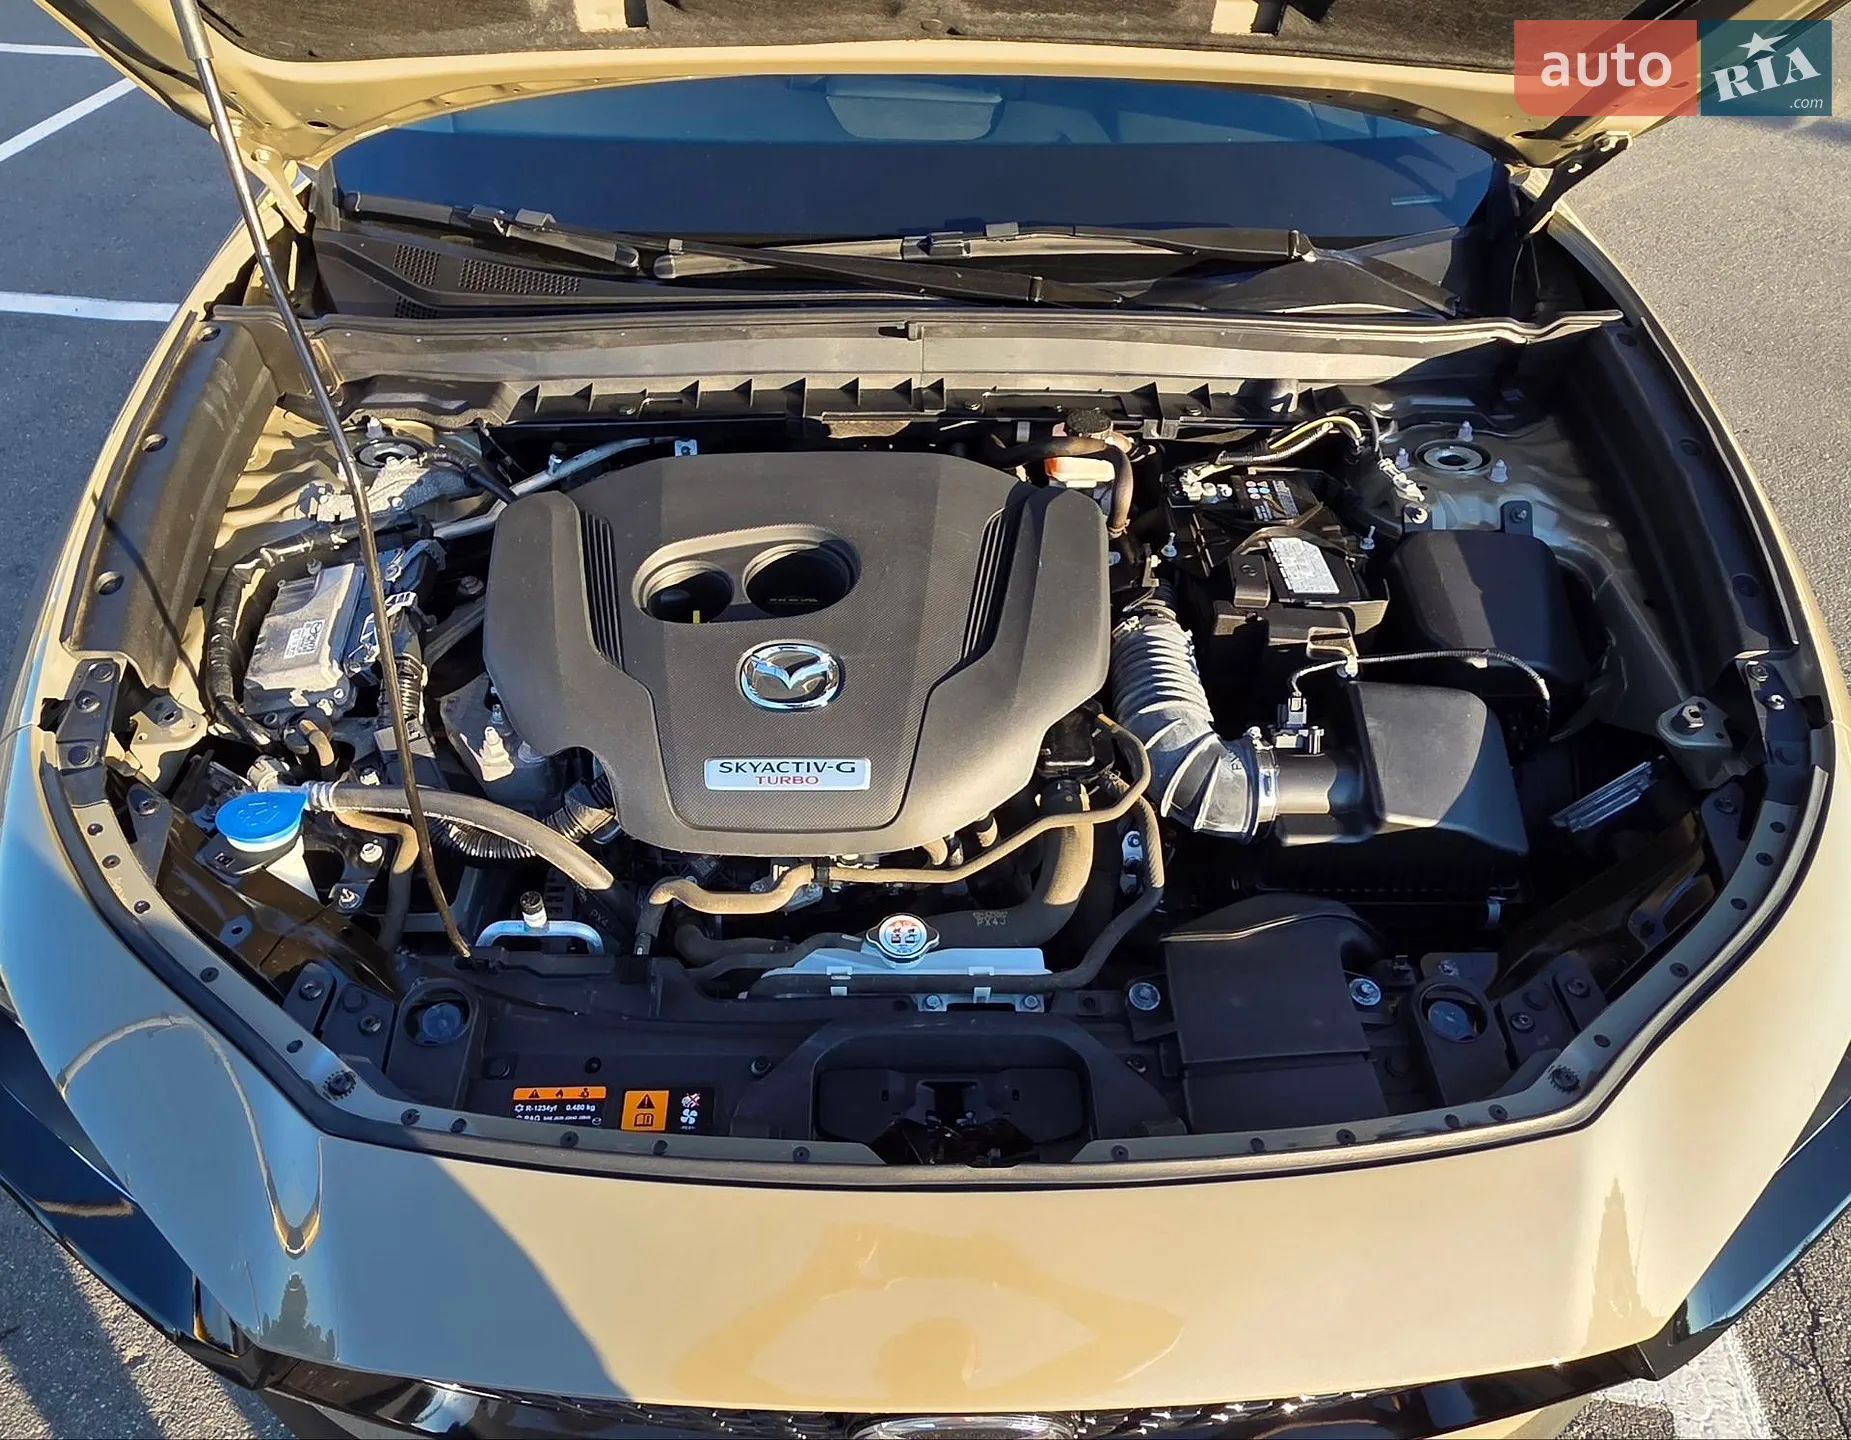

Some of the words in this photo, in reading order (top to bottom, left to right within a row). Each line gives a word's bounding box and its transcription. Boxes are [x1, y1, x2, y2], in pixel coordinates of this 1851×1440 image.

[718, 761, 856, 774] SKYACTIV-G
[756, 776, 820, 785] TURBO
[525, 1104, 558, 1113] R-1234yf
[586, 1103, 596, 1112] kg
